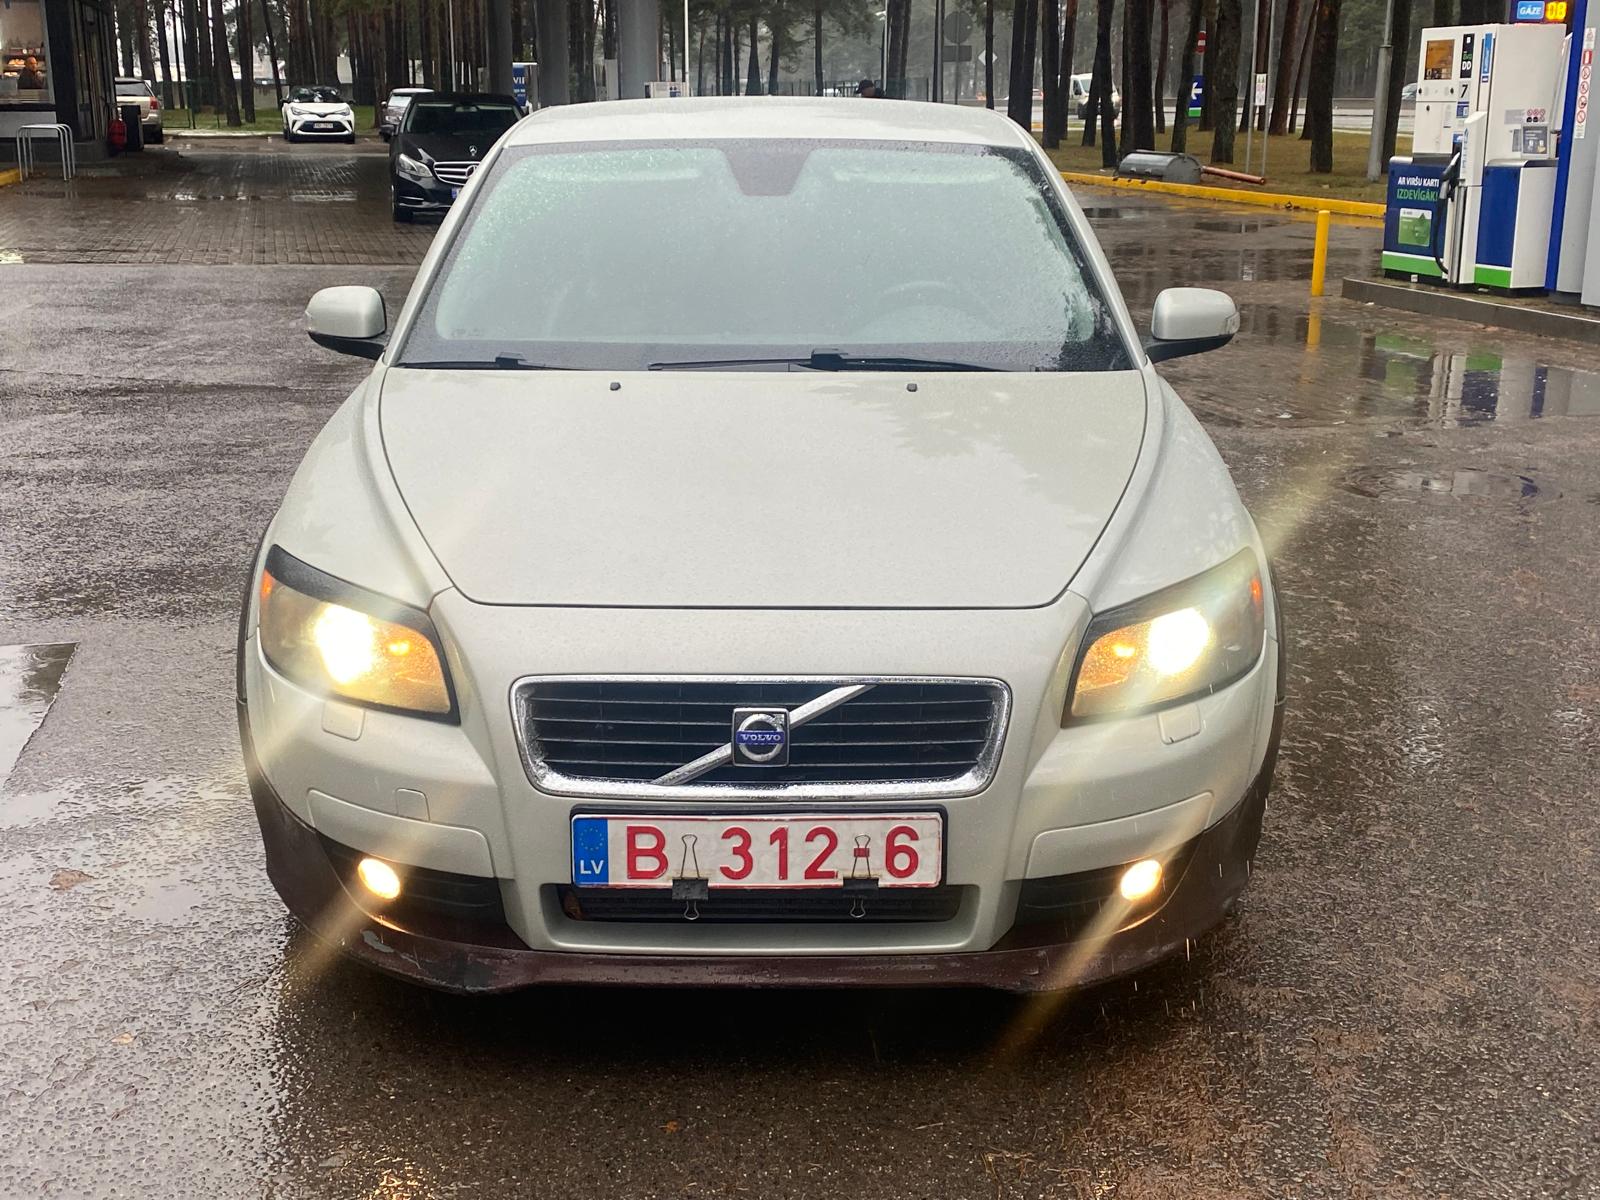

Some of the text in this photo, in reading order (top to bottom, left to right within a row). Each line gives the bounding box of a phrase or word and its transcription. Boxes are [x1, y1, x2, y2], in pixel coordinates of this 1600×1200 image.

[1460, 84, 1468, 98] 7
[626, 825, 669, 880] B
[580, 860, 604, 874] LV
